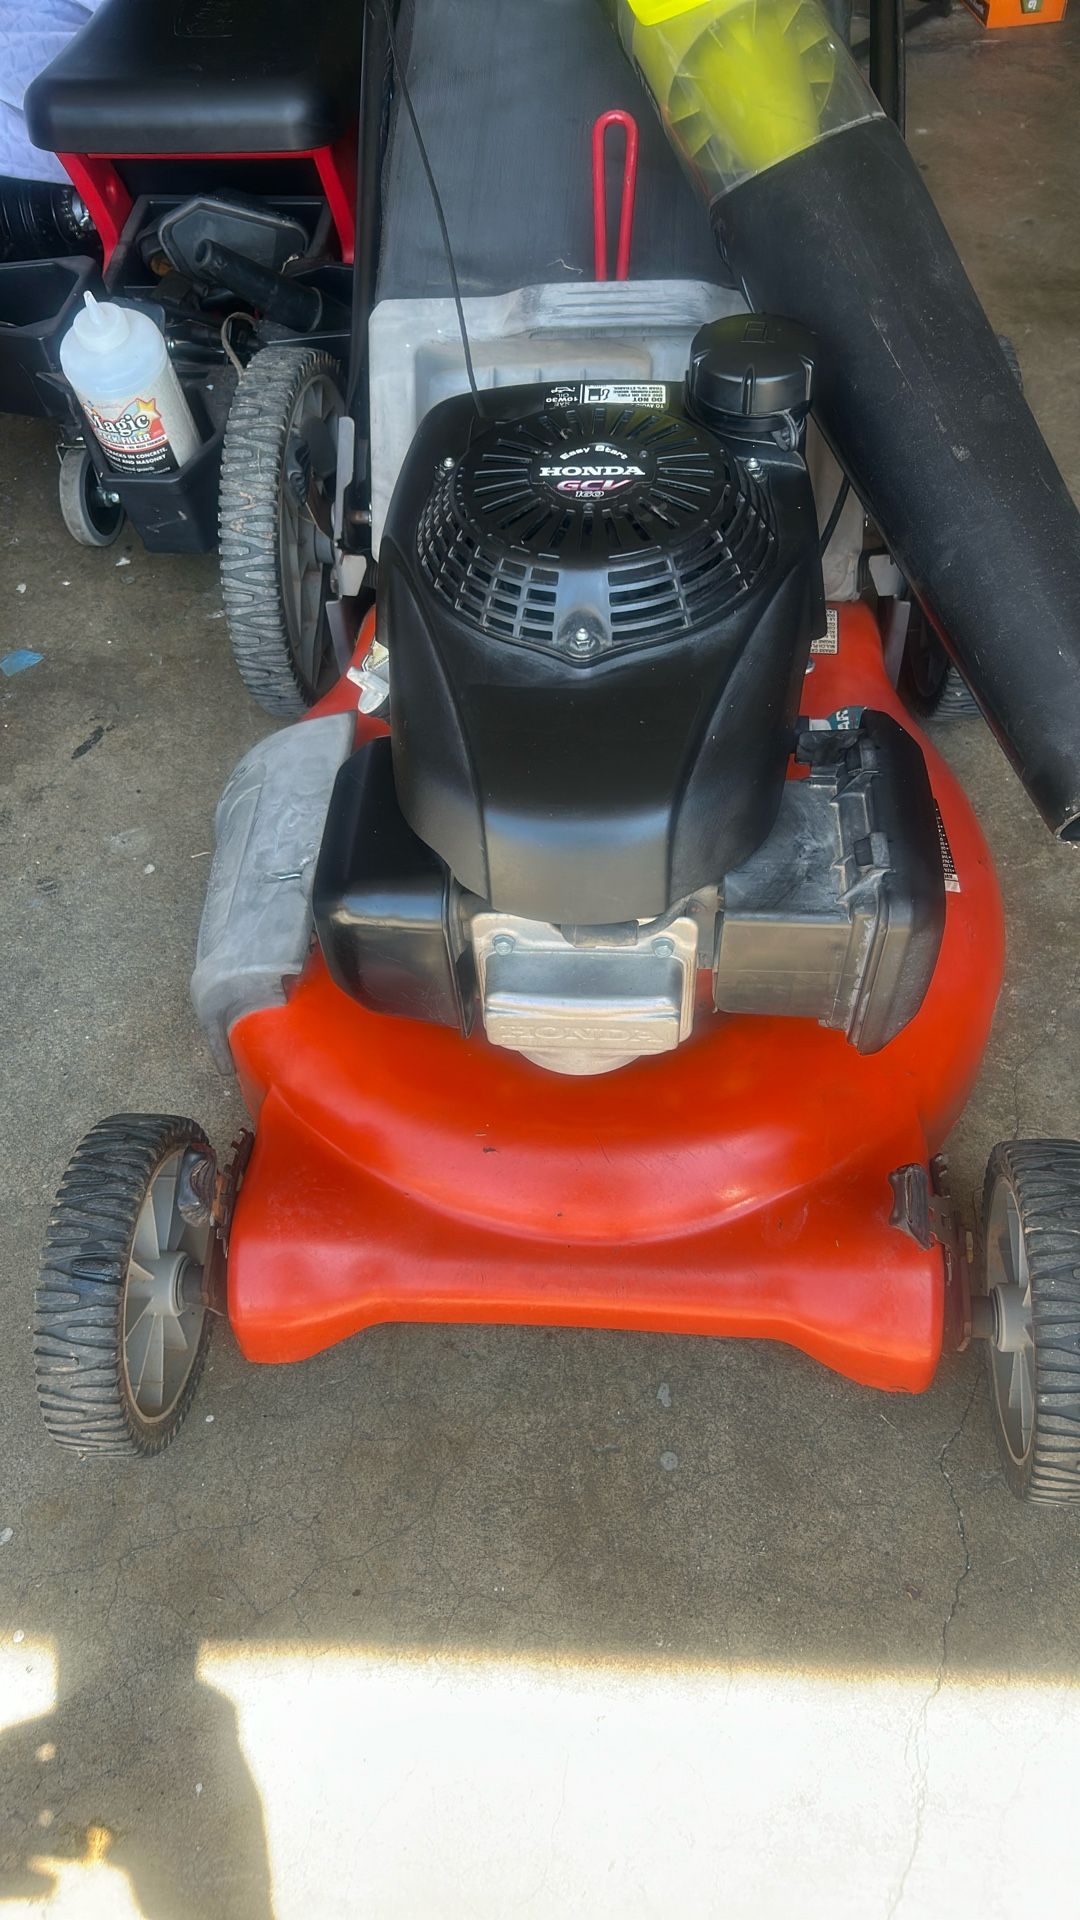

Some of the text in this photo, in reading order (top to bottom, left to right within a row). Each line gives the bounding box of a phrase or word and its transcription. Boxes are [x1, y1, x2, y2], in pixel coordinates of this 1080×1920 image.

[121, 433, 151, 445] FILLER
[136, 447, 168, 459] CONCRETE,
[560, 444, 628, 460] Easy Start
[136, 454, 166, 465] MASONRY
[539, 466, 646, 477] HONDA
[556, 480, 633, 491] GCV
[500, 1025, 665, 1043] HONDA
